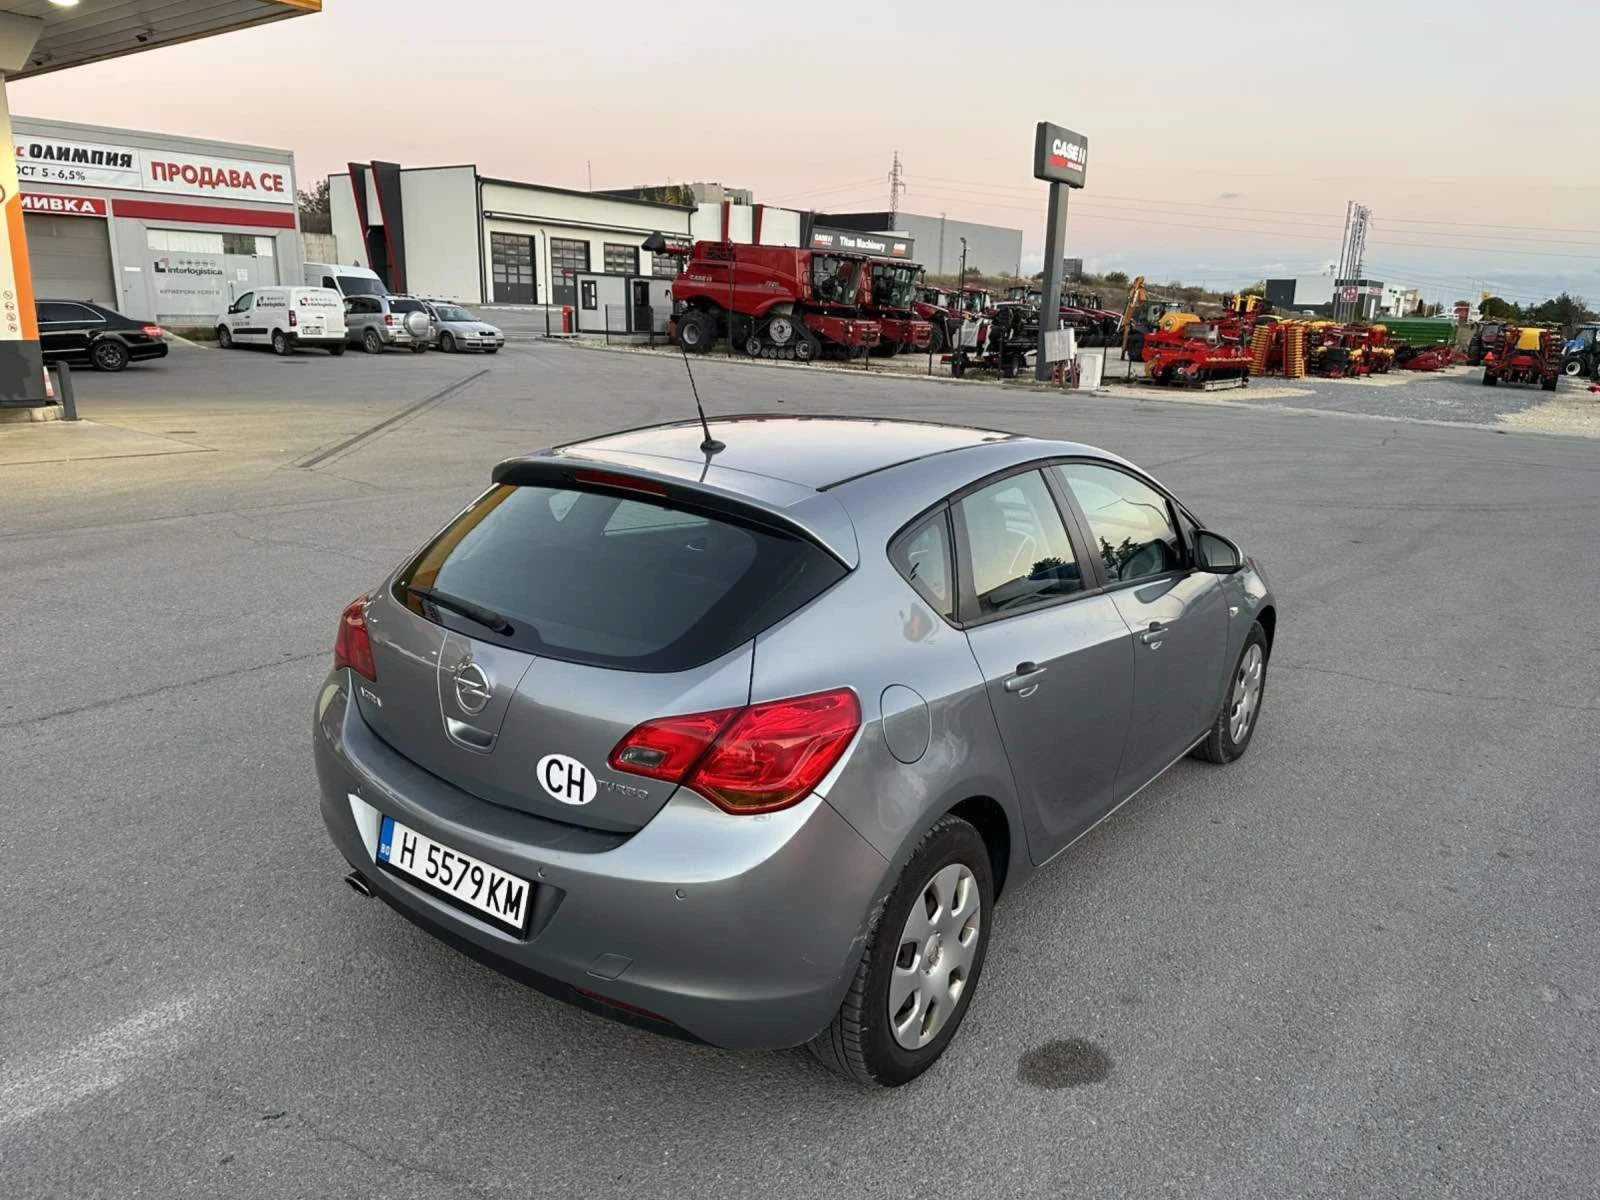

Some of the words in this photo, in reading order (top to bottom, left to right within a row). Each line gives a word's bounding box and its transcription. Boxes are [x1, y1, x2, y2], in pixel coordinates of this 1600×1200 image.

[29, 143, 132, 168] ОЛИМПИЯ
[1053, 138, 1079, 162] CASE
[42, 168, 49, 177] 5
[58, 169, 86, 181] 6,5%
[151, 161, 256, 190] ПРОДАВА
[260, 173, 284, 192] СЕ
[840, 235, 855, 247] Titan
[856, 238, 885, 252] Machinery
[546, 758, 585, 802] CH
[597, 779, 649, 800] TURBO
